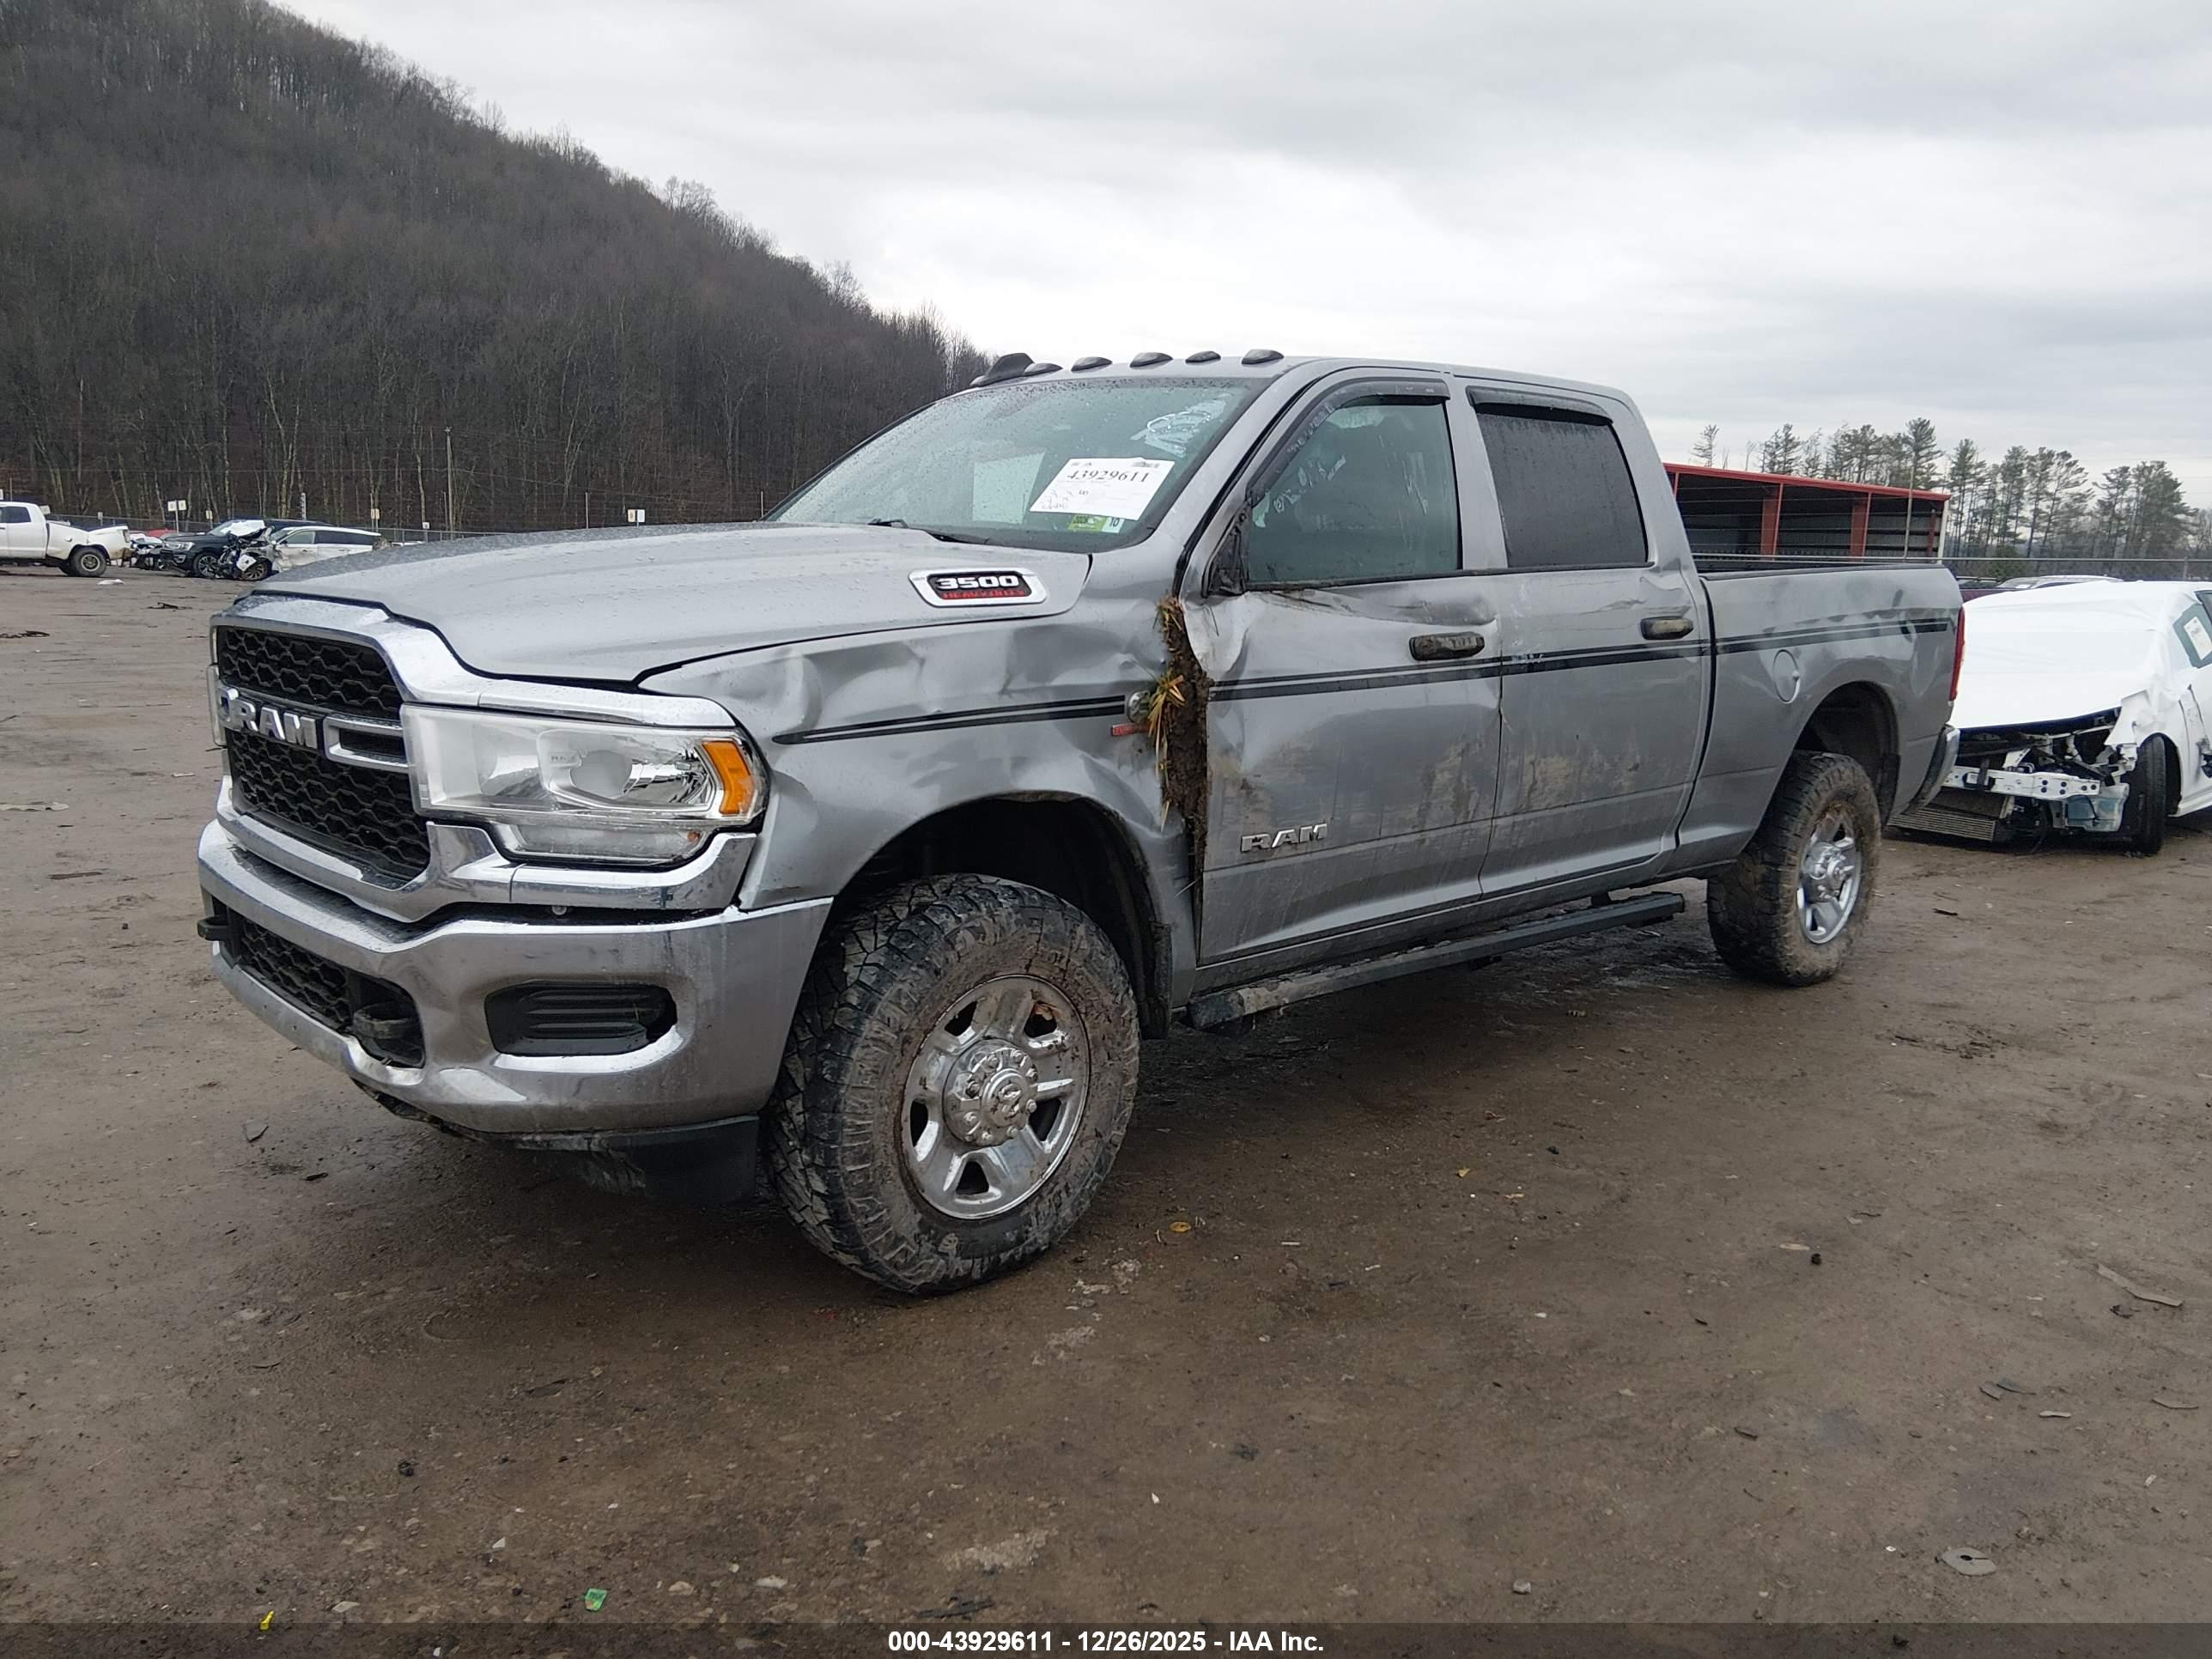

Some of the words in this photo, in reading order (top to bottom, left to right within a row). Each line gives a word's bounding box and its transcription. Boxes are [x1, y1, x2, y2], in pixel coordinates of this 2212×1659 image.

[1066, 470, 1150, 483] 43929611
[936, 575, 1019, 590] 3500
[230, 698, 318, 750] RAM
[1240, 823, 1328, 853] RAM
